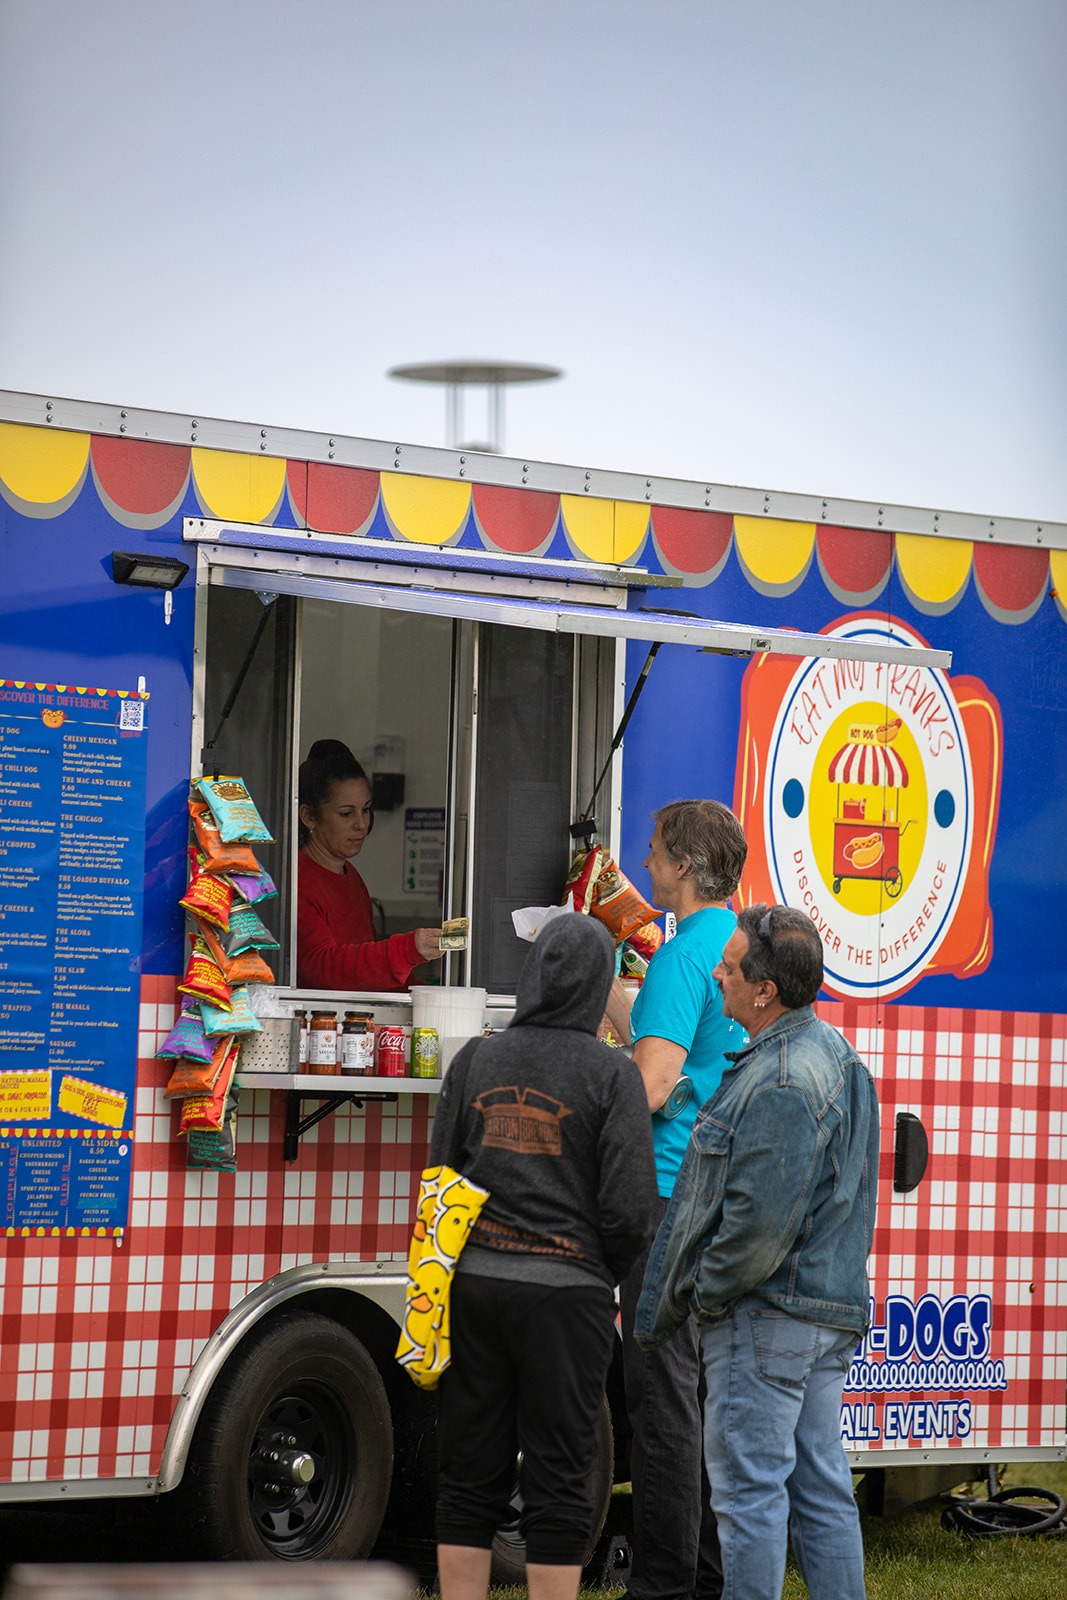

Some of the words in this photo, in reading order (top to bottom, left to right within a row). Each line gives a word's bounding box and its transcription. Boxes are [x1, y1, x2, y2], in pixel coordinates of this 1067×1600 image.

[38, 694, 54, 705] THE
[57, 695, 109, 710] DIFFERENCE
[790, 664, 832, 744] EAT
[99, 877, 130, 885] BUFFALO
[793, 849, 842, 954] DISCOVER
[847, 944, 873, 966] THE
[880, 859, 947, 965] DIFFERENCE
[3, 1004, 32, 1012] WRAPPED
[854, 1294, 992, 1362] -DOGS
[840, 1402, 880, 1440] ALL
[885, 1399, 972, 1440] EVENTS
